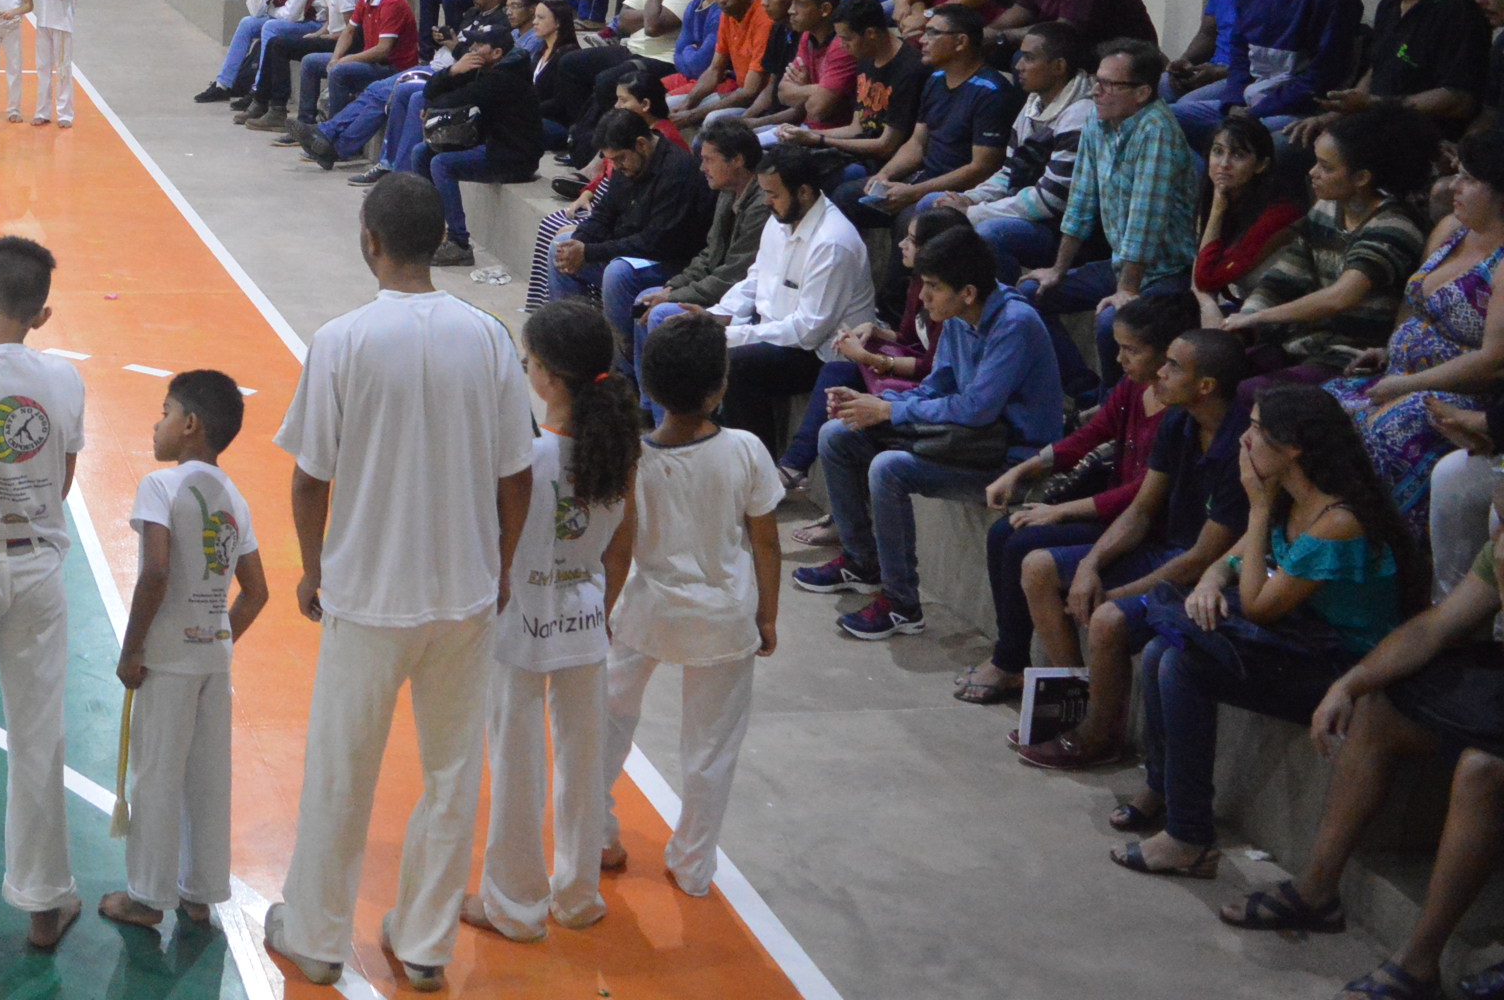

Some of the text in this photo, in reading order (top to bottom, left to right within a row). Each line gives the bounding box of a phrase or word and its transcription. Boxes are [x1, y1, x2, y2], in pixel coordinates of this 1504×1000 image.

[5, 413, 17, 435] ARTE
[34, 411, 48, 433] JOGO
[521, 605, 604, 639] Narizinh
